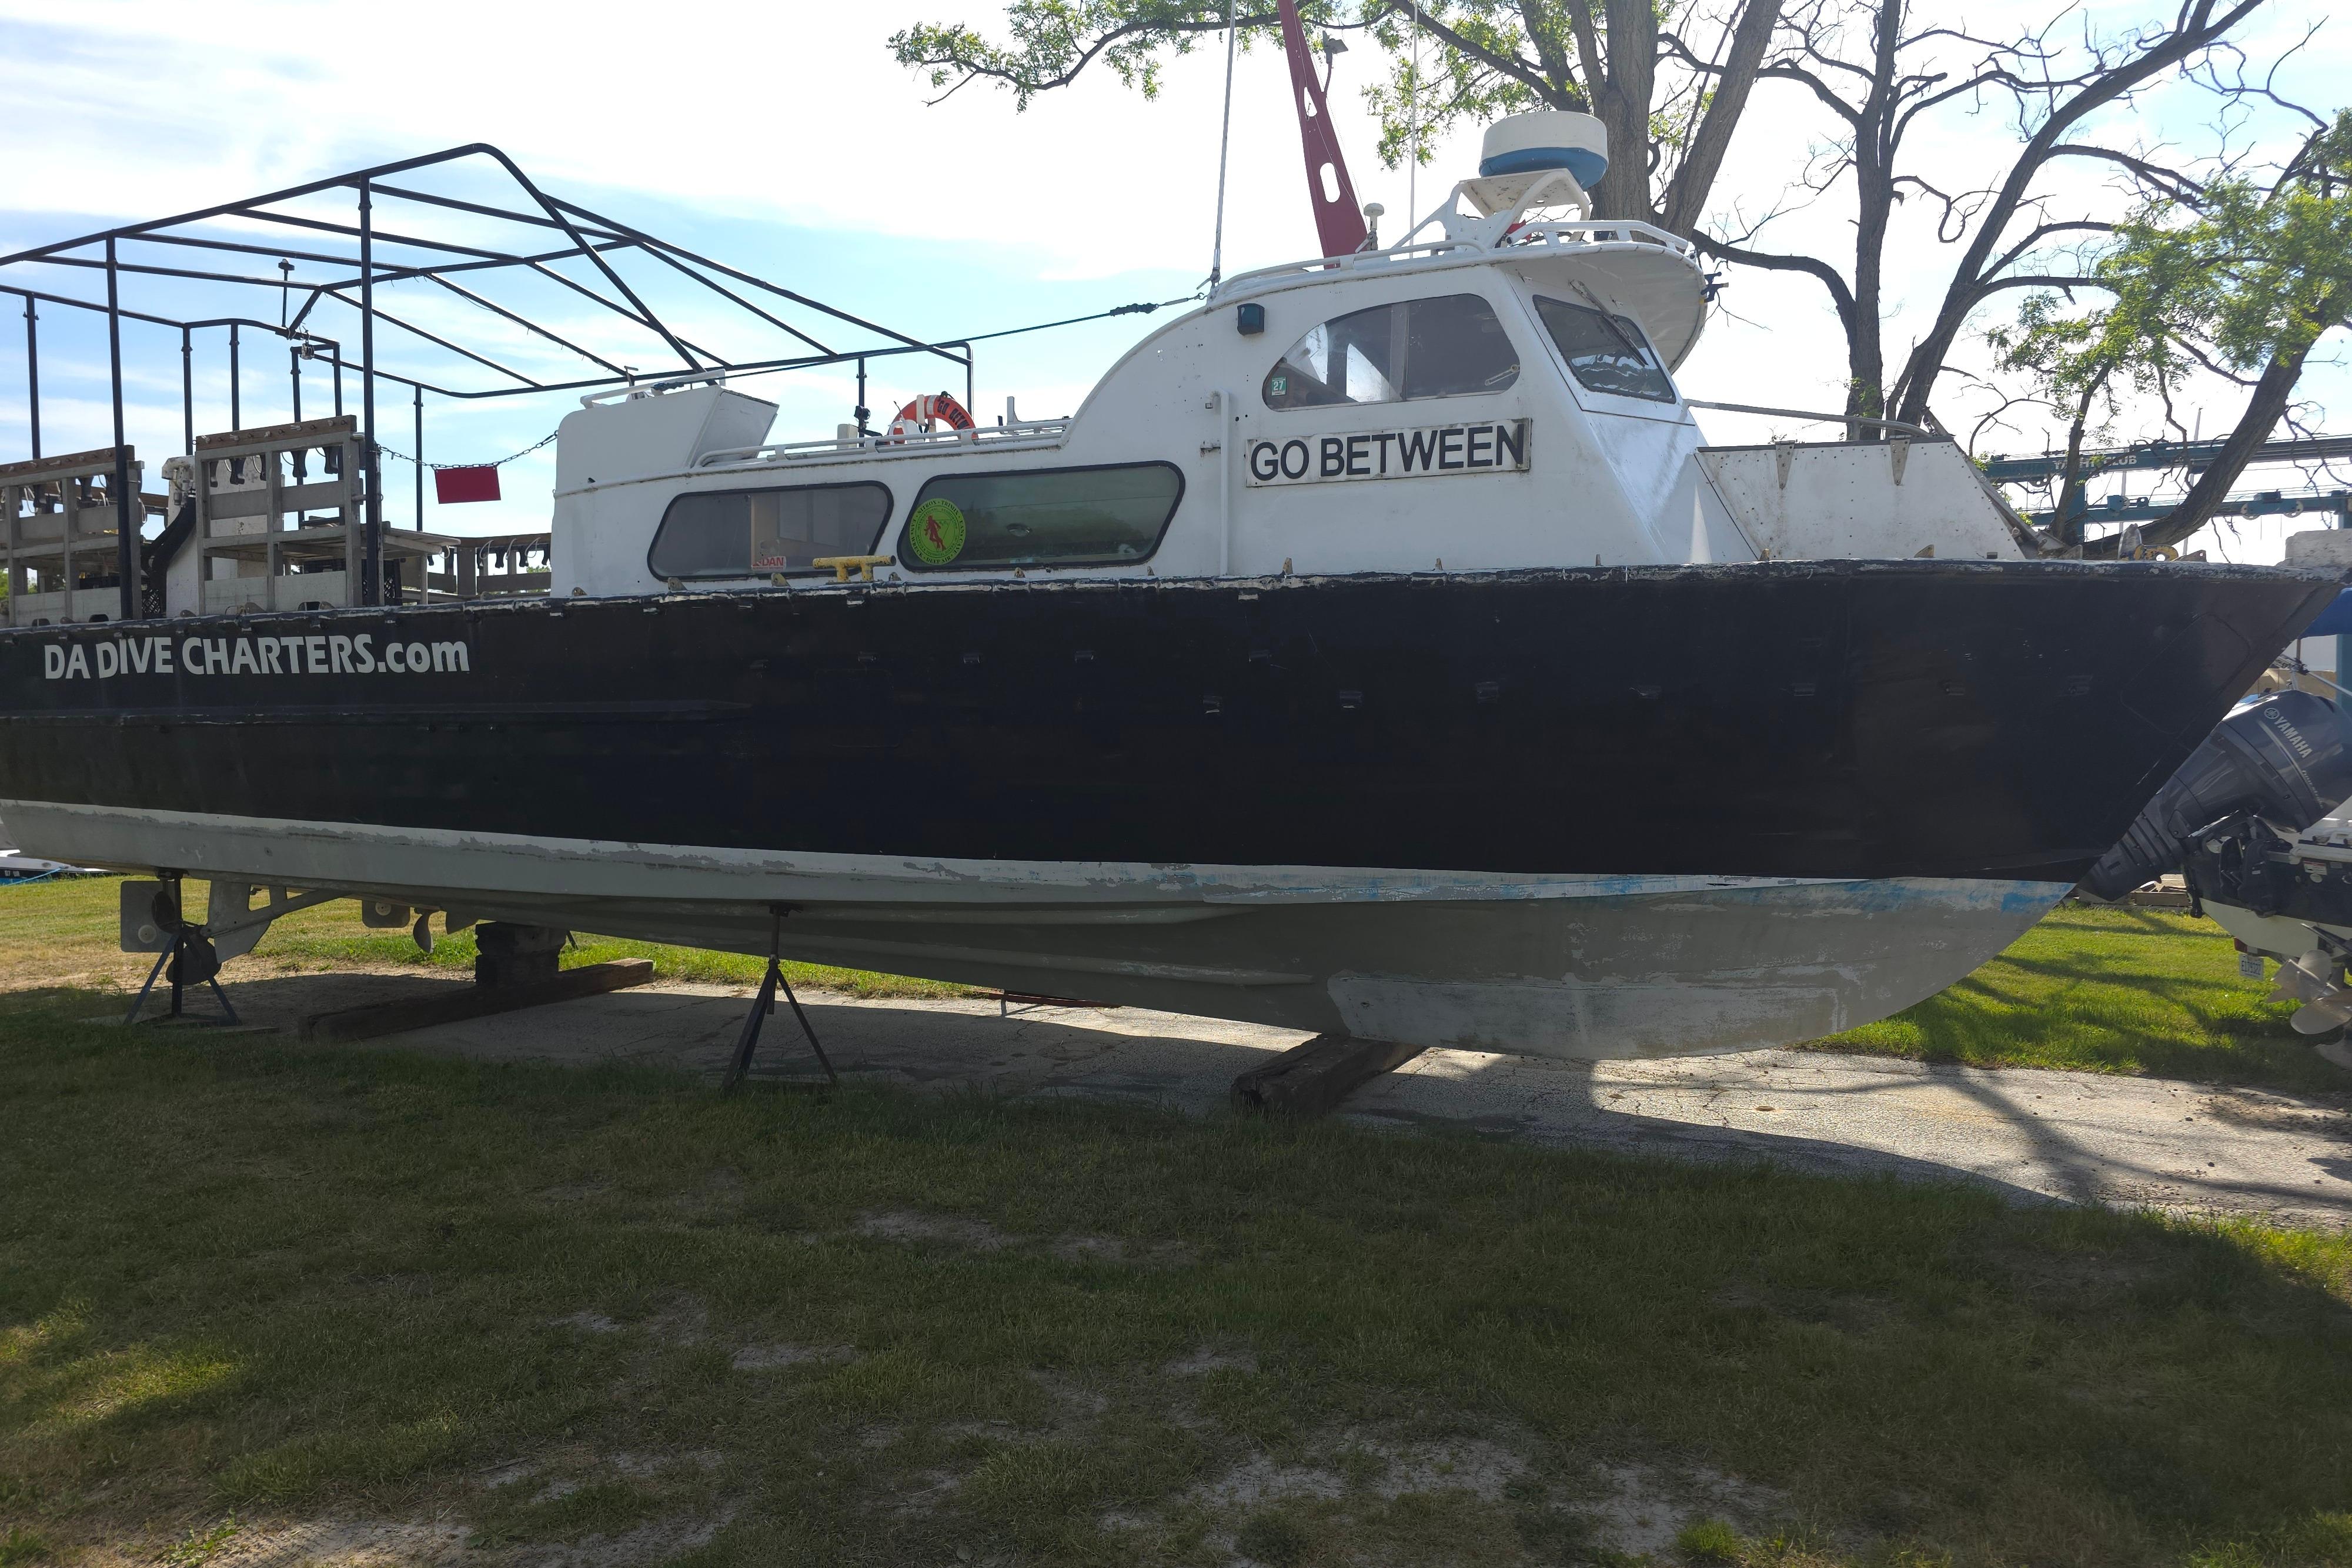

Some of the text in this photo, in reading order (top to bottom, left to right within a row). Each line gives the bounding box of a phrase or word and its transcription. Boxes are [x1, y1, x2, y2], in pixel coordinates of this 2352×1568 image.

[1274, 381, 1283, 390] 27
[938, 400, 950, 414] GO
[1251, 424, 1524, 481] GO BETWEEN
[918, 500, 958, 515] NITROX TRIMIX
[911, 537, 923, 557] WRECK
[762, 557, 784, 566] DAN
[45, 634, 470, 679] DA DIVE CHARTERS.com
[2274, 716, 2313, 758] YAMAHA
